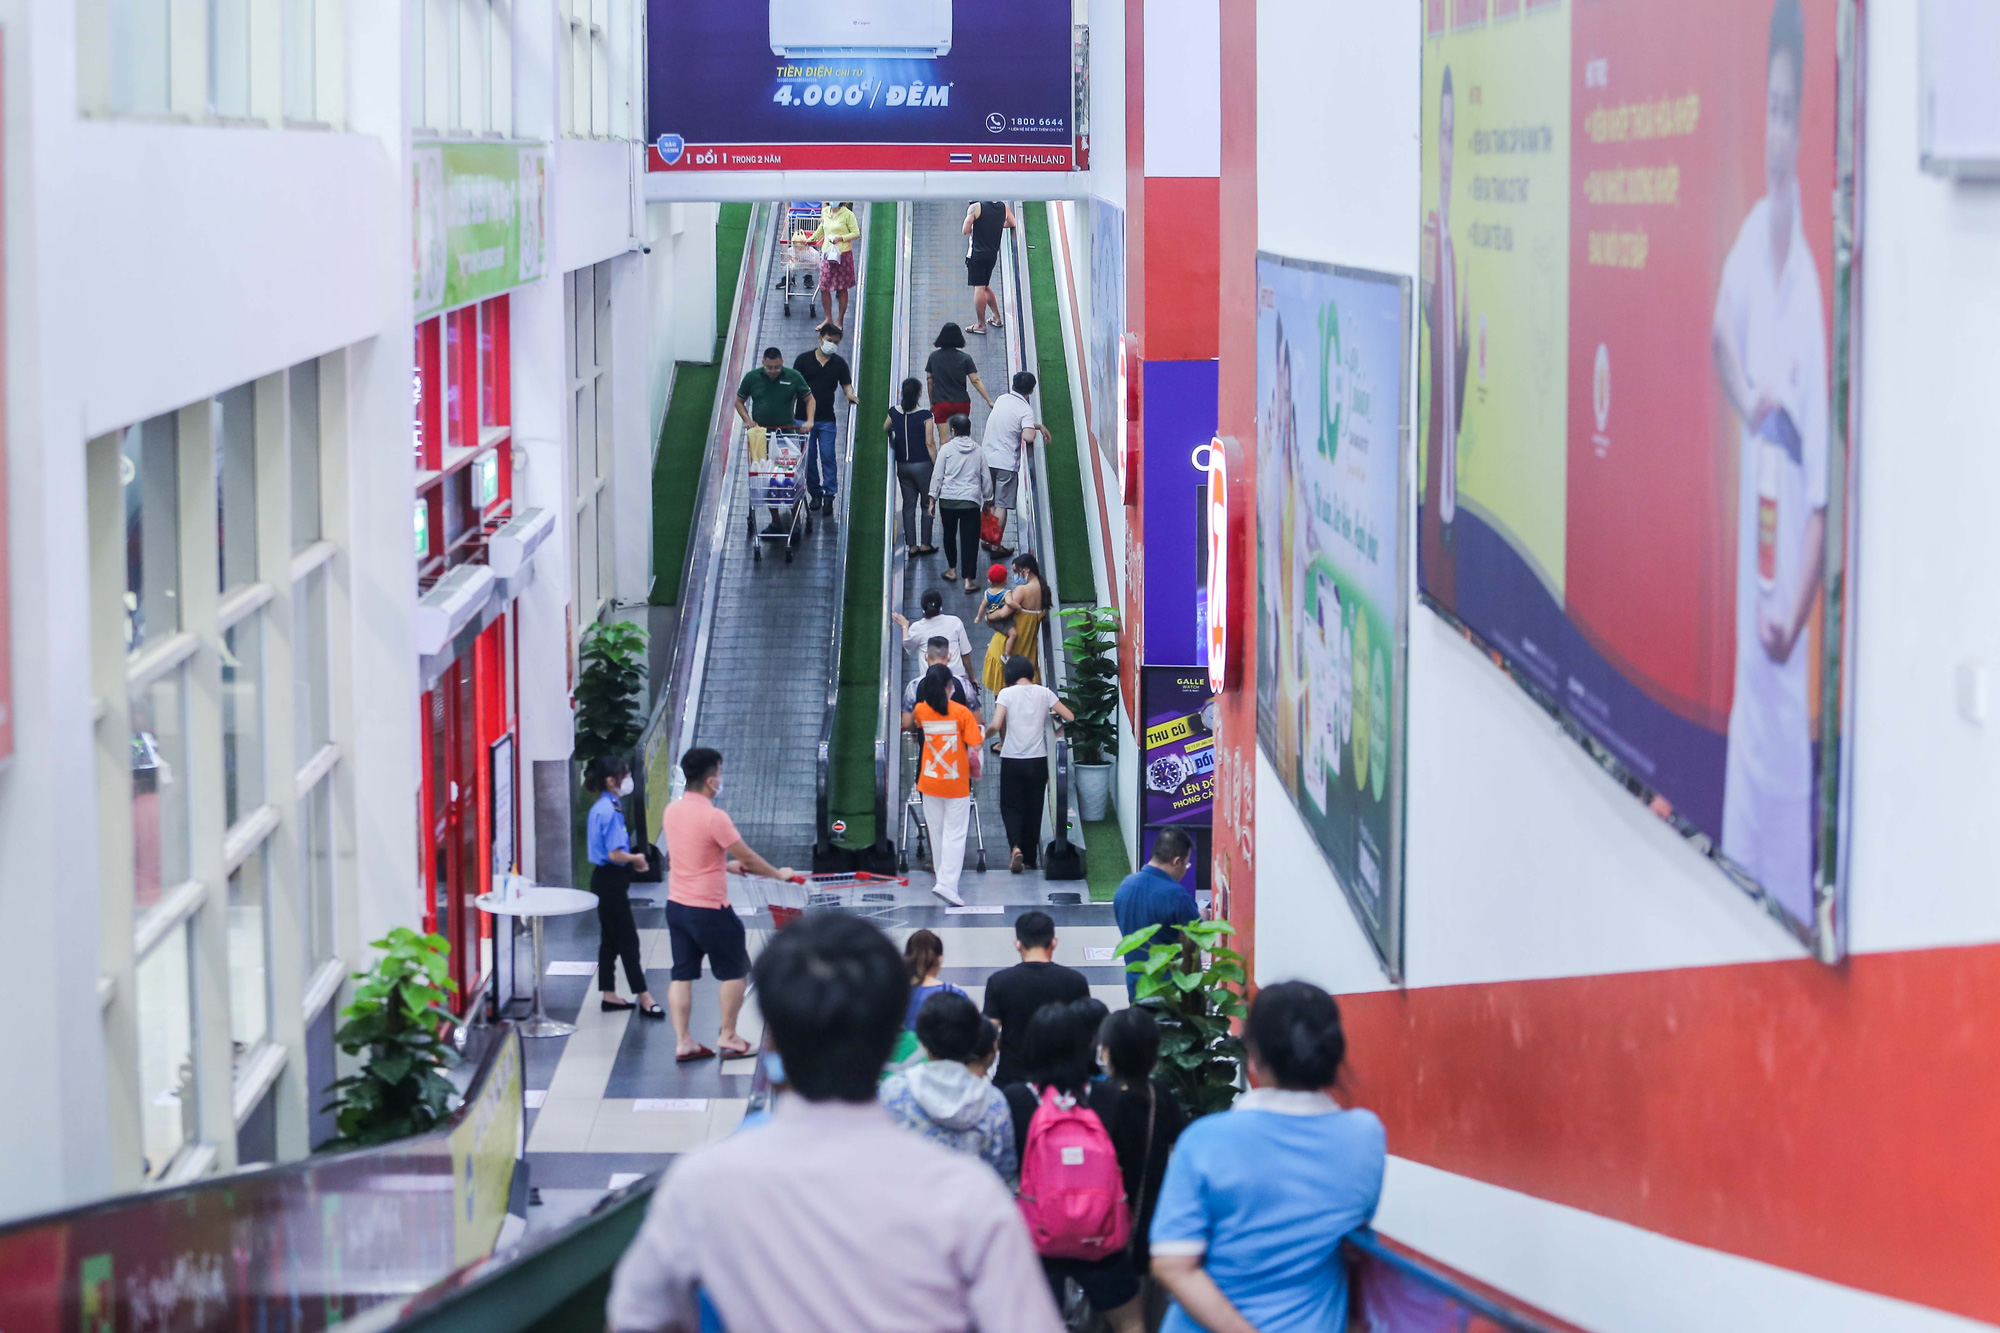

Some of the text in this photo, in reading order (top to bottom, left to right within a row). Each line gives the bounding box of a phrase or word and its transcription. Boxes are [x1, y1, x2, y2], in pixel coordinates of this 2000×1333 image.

[776, 64, 802, 78] TIỀN
[805, 64, 833, 79] ĐIỆN
[1011, 118, 1064, 126] 1800 6644
[696, 149, 718, 164] ĐỔI
[732, 156, 756, 164] TRONG
[757, 156, 763, 164] 2
[764, 154, 782, 164] NĂM
[978, 154, 1066, 165] MADE IN THAILAND
[1176, 678, 1205, 686] GALLE
[1147, 729, 1169, 744] THU
[1181, 782, 1200, 796] LÊN
[1173, 794, 1201, 809] PHONG
